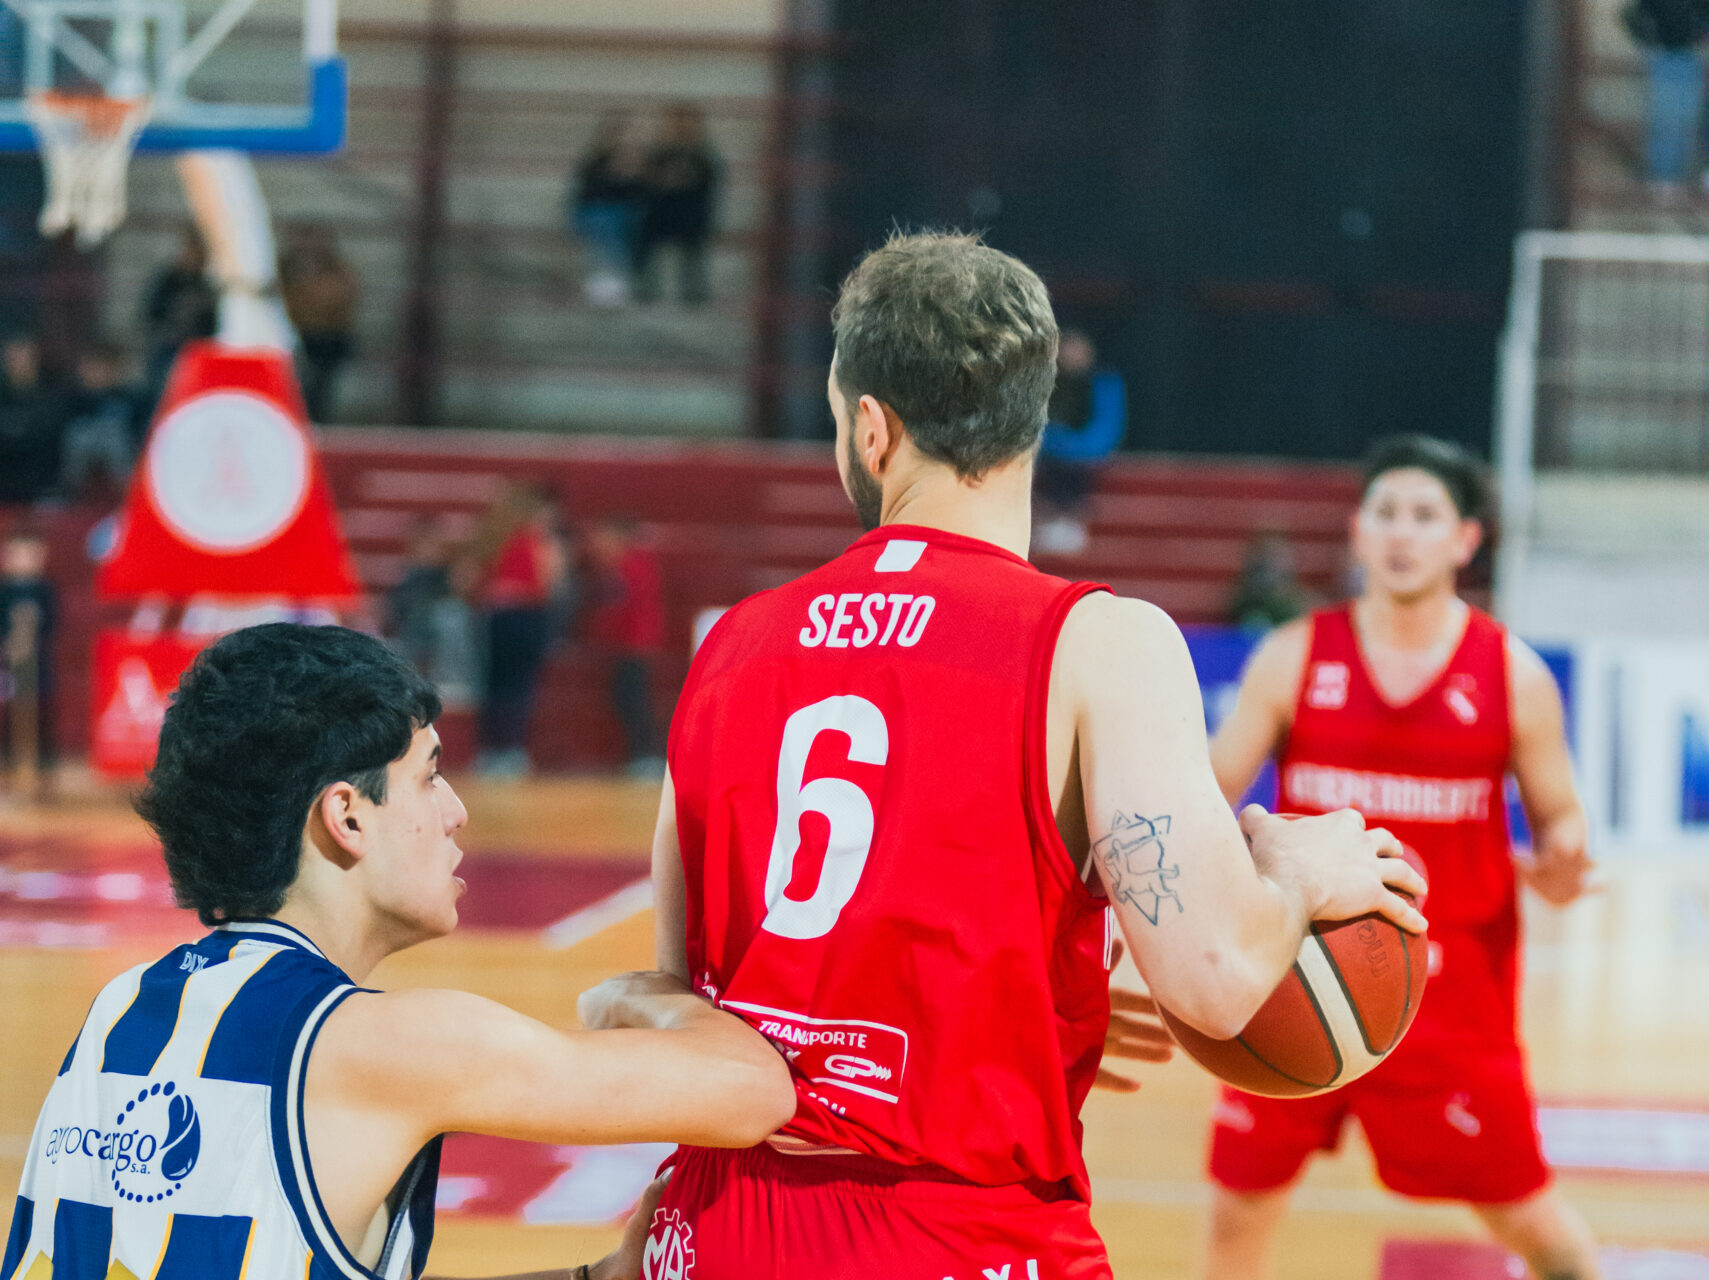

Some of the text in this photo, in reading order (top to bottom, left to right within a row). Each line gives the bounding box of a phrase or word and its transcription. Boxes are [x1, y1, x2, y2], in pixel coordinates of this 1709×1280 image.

[799, 593, 936, 649] SESTO
[761, 694, 889, 940] 6
[759, 1020, 867, 1048] TRANPORTE
[825, 1054, 878, 1078] GP
[46, 1126, 157, 1171] arocargo
[130, 1163, 151, 1174] s.a.
